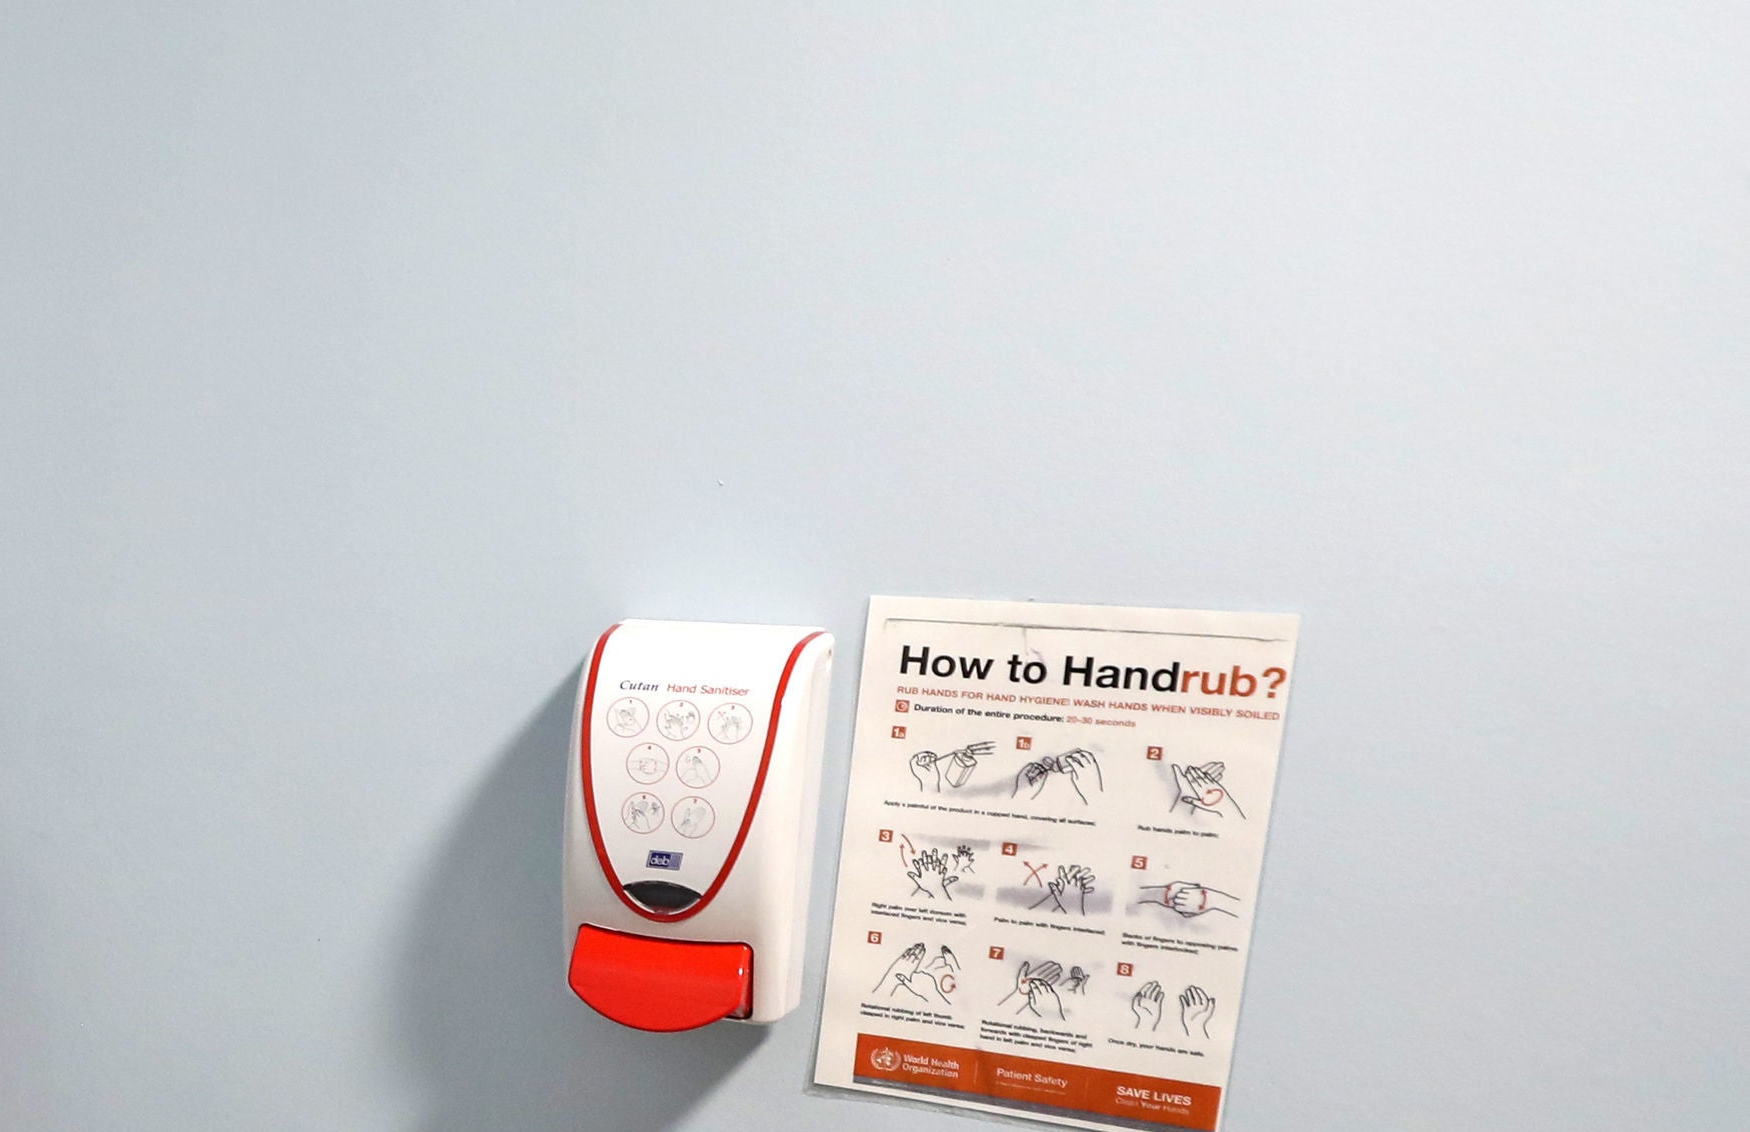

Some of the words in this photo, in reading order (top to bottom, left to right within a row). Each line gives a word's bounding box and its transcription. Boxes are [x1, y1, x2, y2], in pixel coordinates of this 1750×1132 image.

[899, 645, 994, 679] How
[1006, 654, 1047, 684] to
[1062, 656, 1286, 698] Handrub?
[619, 680, 659, 692] Cutan
[666, 683, 697, 694] Hand
[700, 684, 750, 696] Sanitiser
[896, 685, 918, 694] RUB
[921, 687, 958, 697] HANDS
[960, 690, 983, 699] FOR
[985, 692, 1016, 702] HAND
[1072, 698, 1105, 708] WASH
[1107, 701, 1148, 711] HANDS
[1150, 703, 1186, 713] WHEN
[1189, 706, 1233, 717] VISIBLY
[1235, 709, 1280, 720] SOILED
[913, 703, 953, 713] Duration
[966, 708, 982, 716] the
[984, 710, 1011, 718] entire
[1094, 719, 1135, 727] seconds
[650, 854, 670, 866] deb
[901, 1062, 958, 1077] Organization
[903, 1054, 928, 1065] World
[930, 1058, 959, 1069] Health
[996, 1067, 1032, 1080] Patient
[1033, 1073, 1067, 1088] Safety
[1116, 1086, 1150, 1099] SAVE
[1153, 1091, 1191, 1105] LIVES
